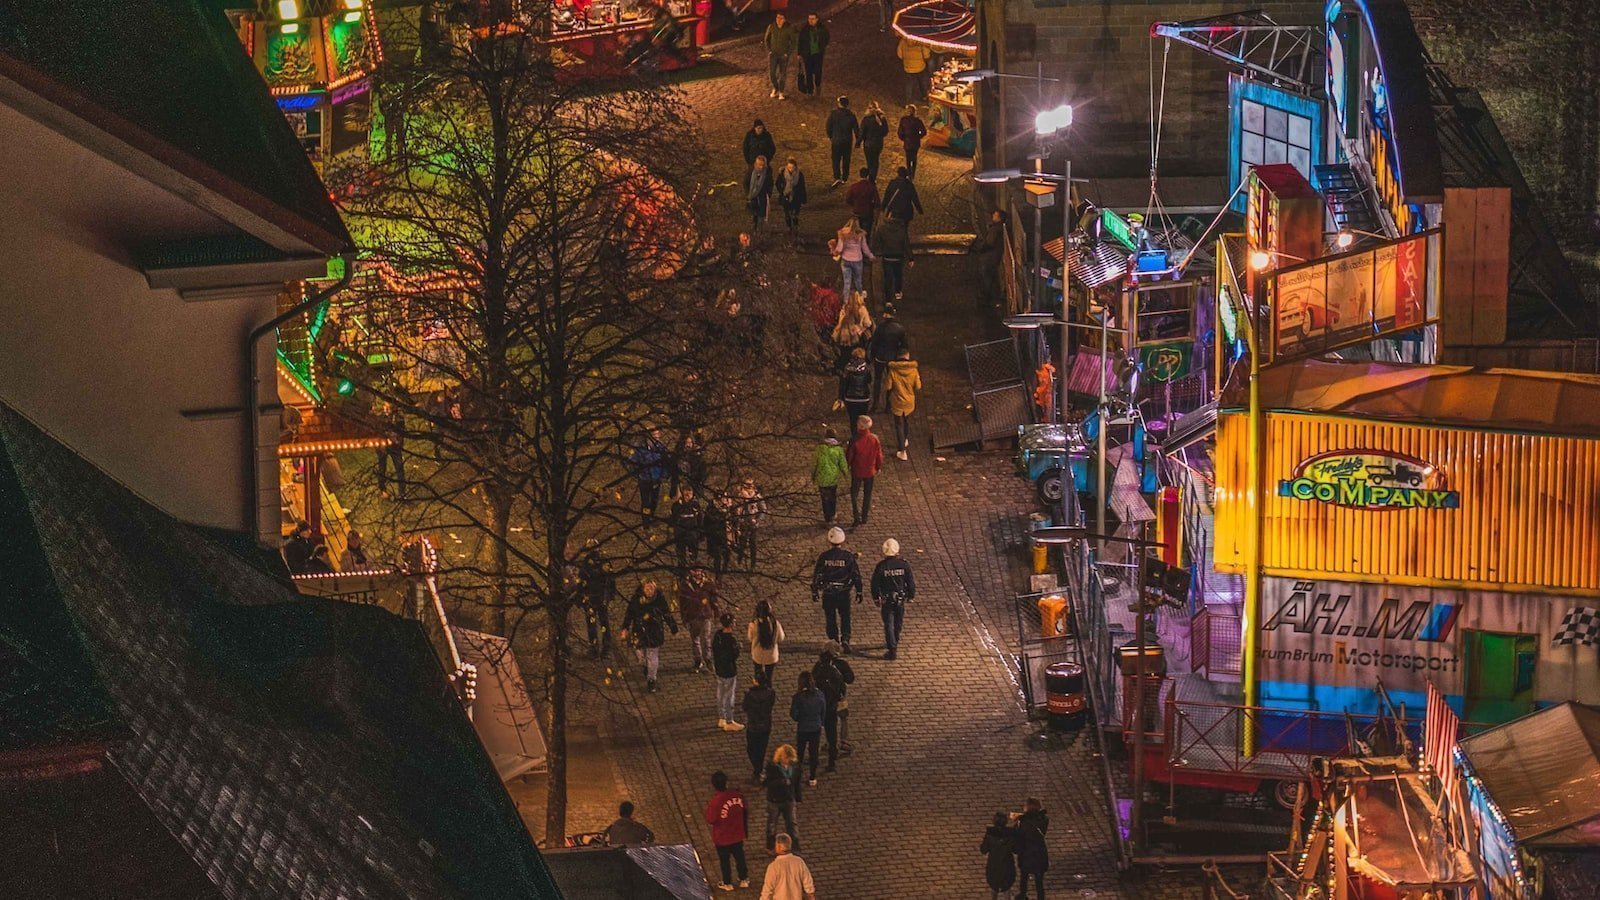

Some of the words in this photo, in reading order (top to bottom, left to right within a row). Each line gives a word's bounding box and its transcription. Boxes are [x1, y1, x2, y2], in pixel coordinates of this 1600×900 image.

[1313, 456, 1363, 478] Freddy's
[884, 568, 905, 577] POLIZEI
[1338, 647, 1459, 673] Motorsport
